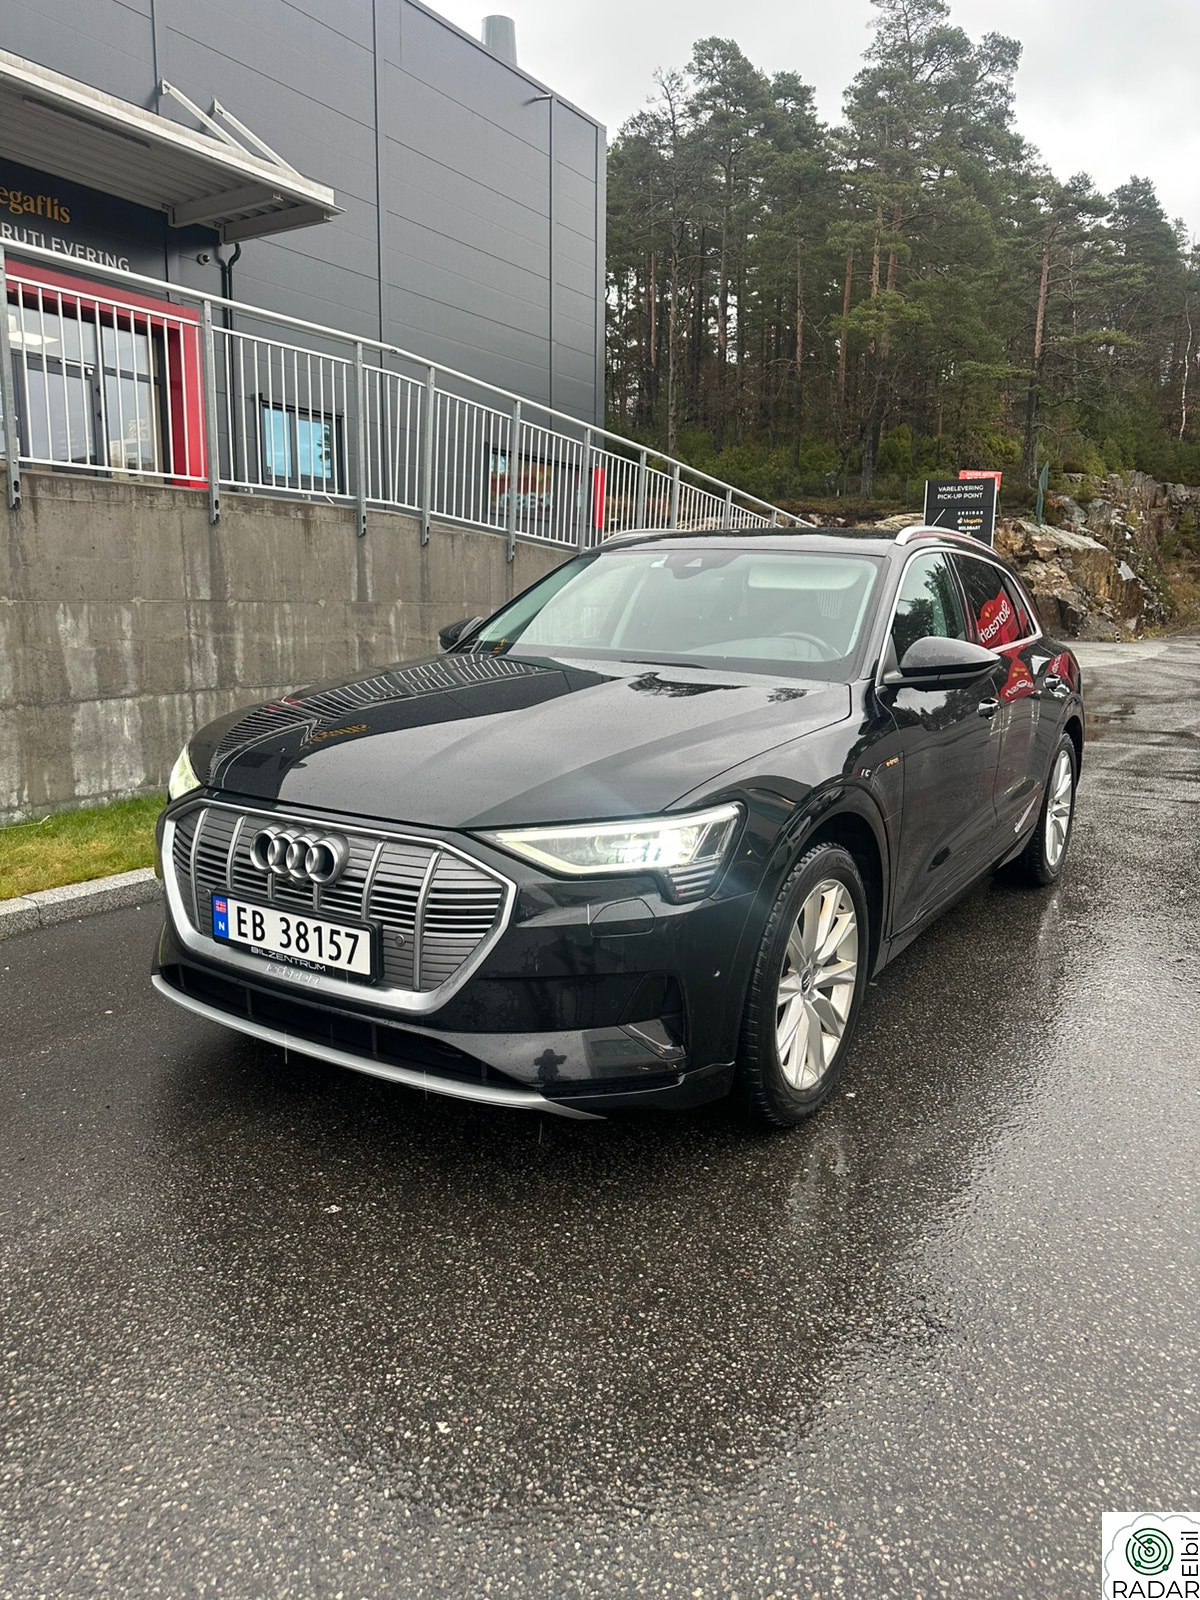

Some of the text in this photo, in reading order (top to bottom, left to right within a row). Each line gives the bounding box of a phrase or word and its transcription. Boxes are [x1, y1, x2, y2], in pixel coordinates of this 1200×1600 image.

[218, 920, 226, 931] N
[236, 905, 360, 965] EB 38157
[250, 946, 326, 972] BILZENTRUM
